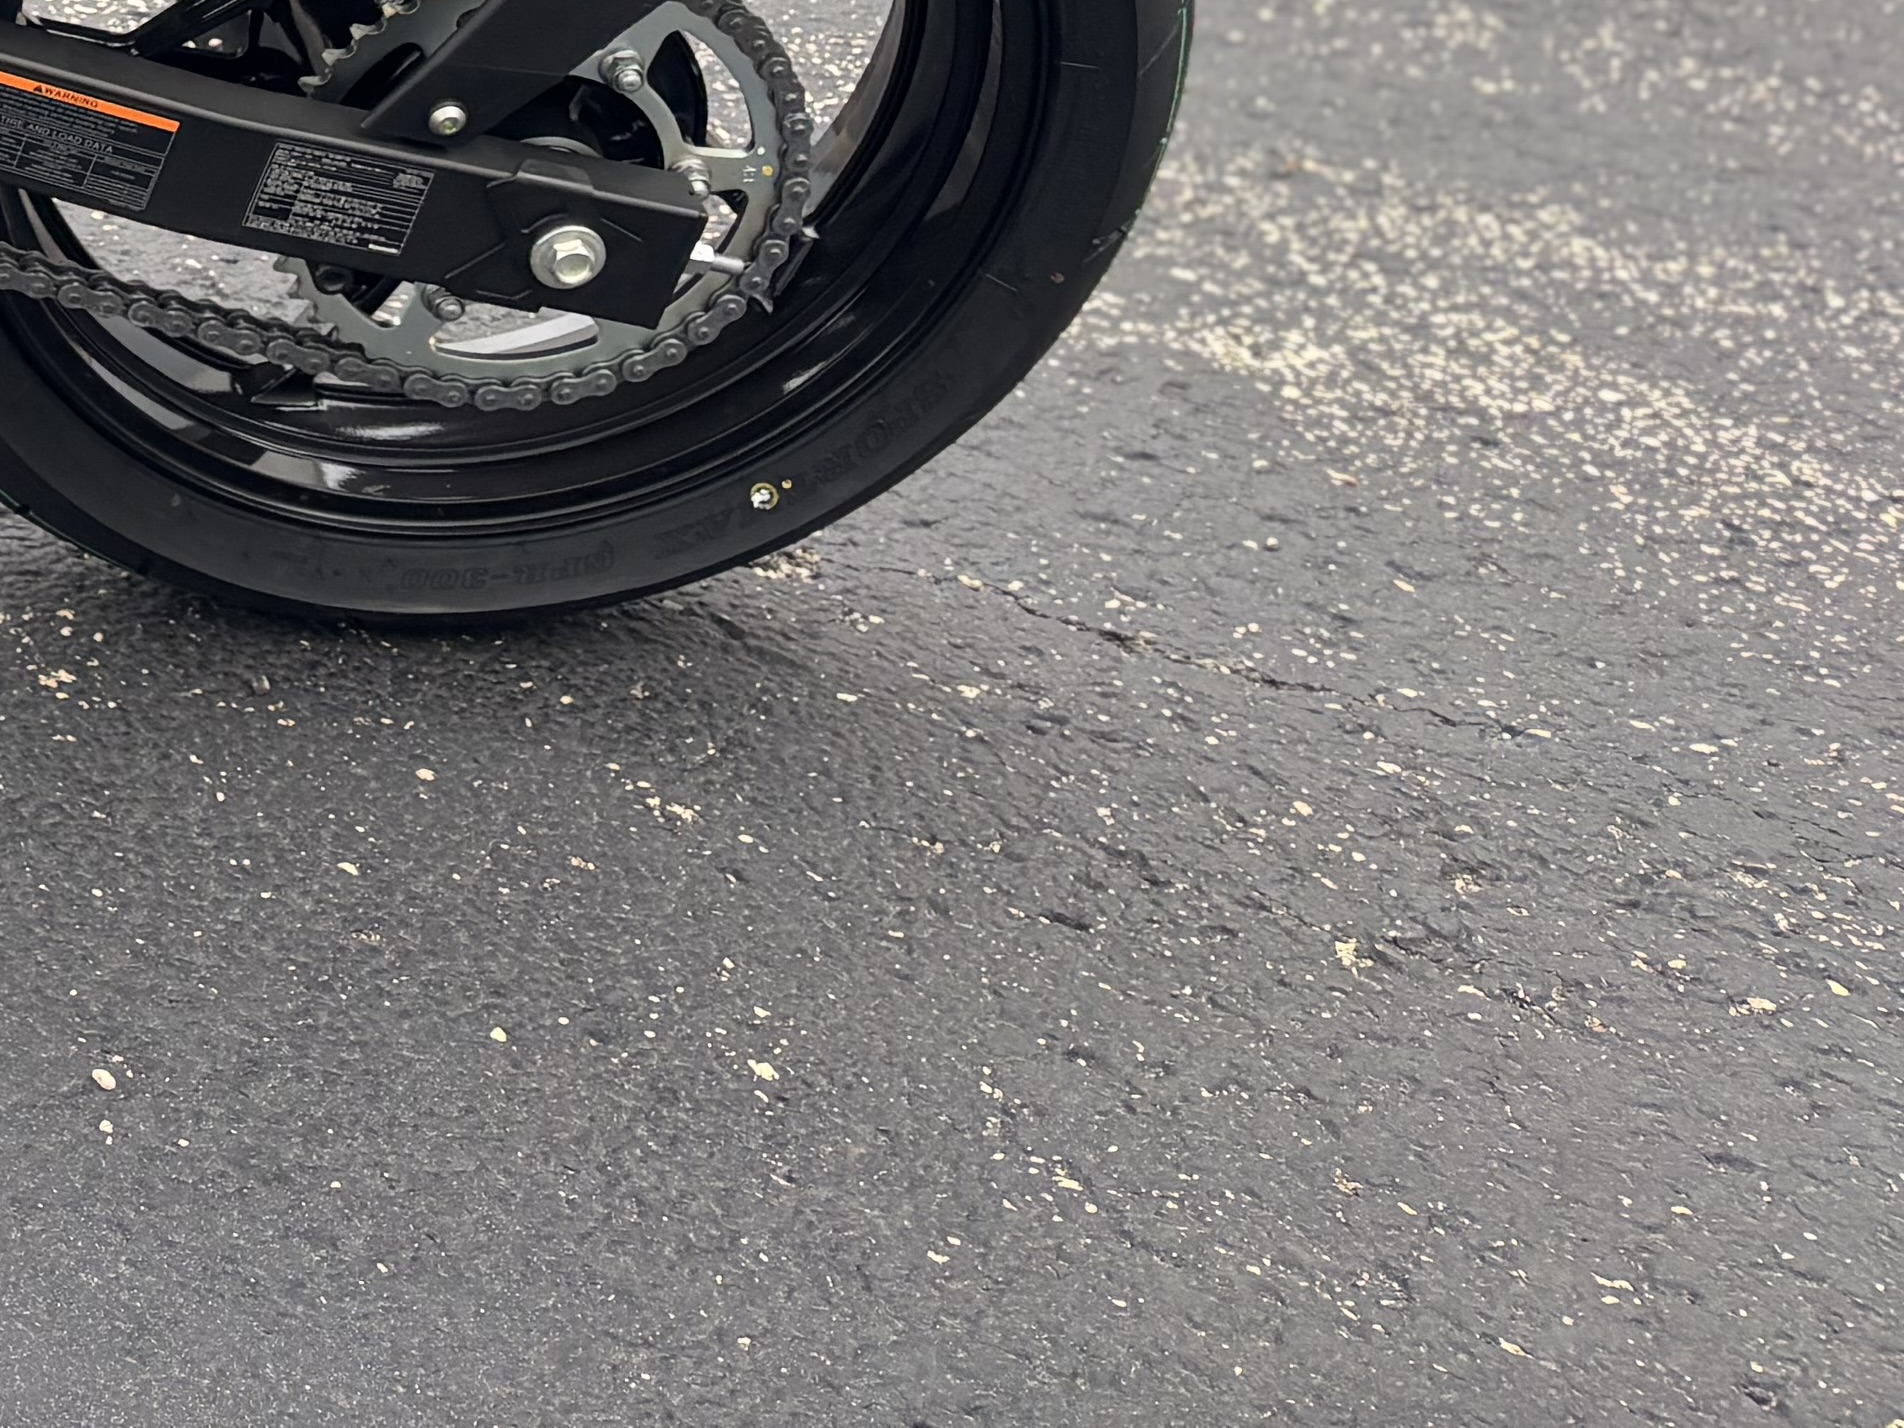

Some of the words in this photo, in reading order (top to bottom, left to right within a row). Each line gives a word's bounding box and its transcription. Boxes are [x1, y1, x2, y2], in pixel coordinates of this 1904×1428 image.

[44, 86, 99, 109] WARNING
[0, 115, 26, 132] TIRE
[28, 123, 50, 137] AND
[51, 129, 83, 145] LOAD
[84, 138, 114, 154] DATA
